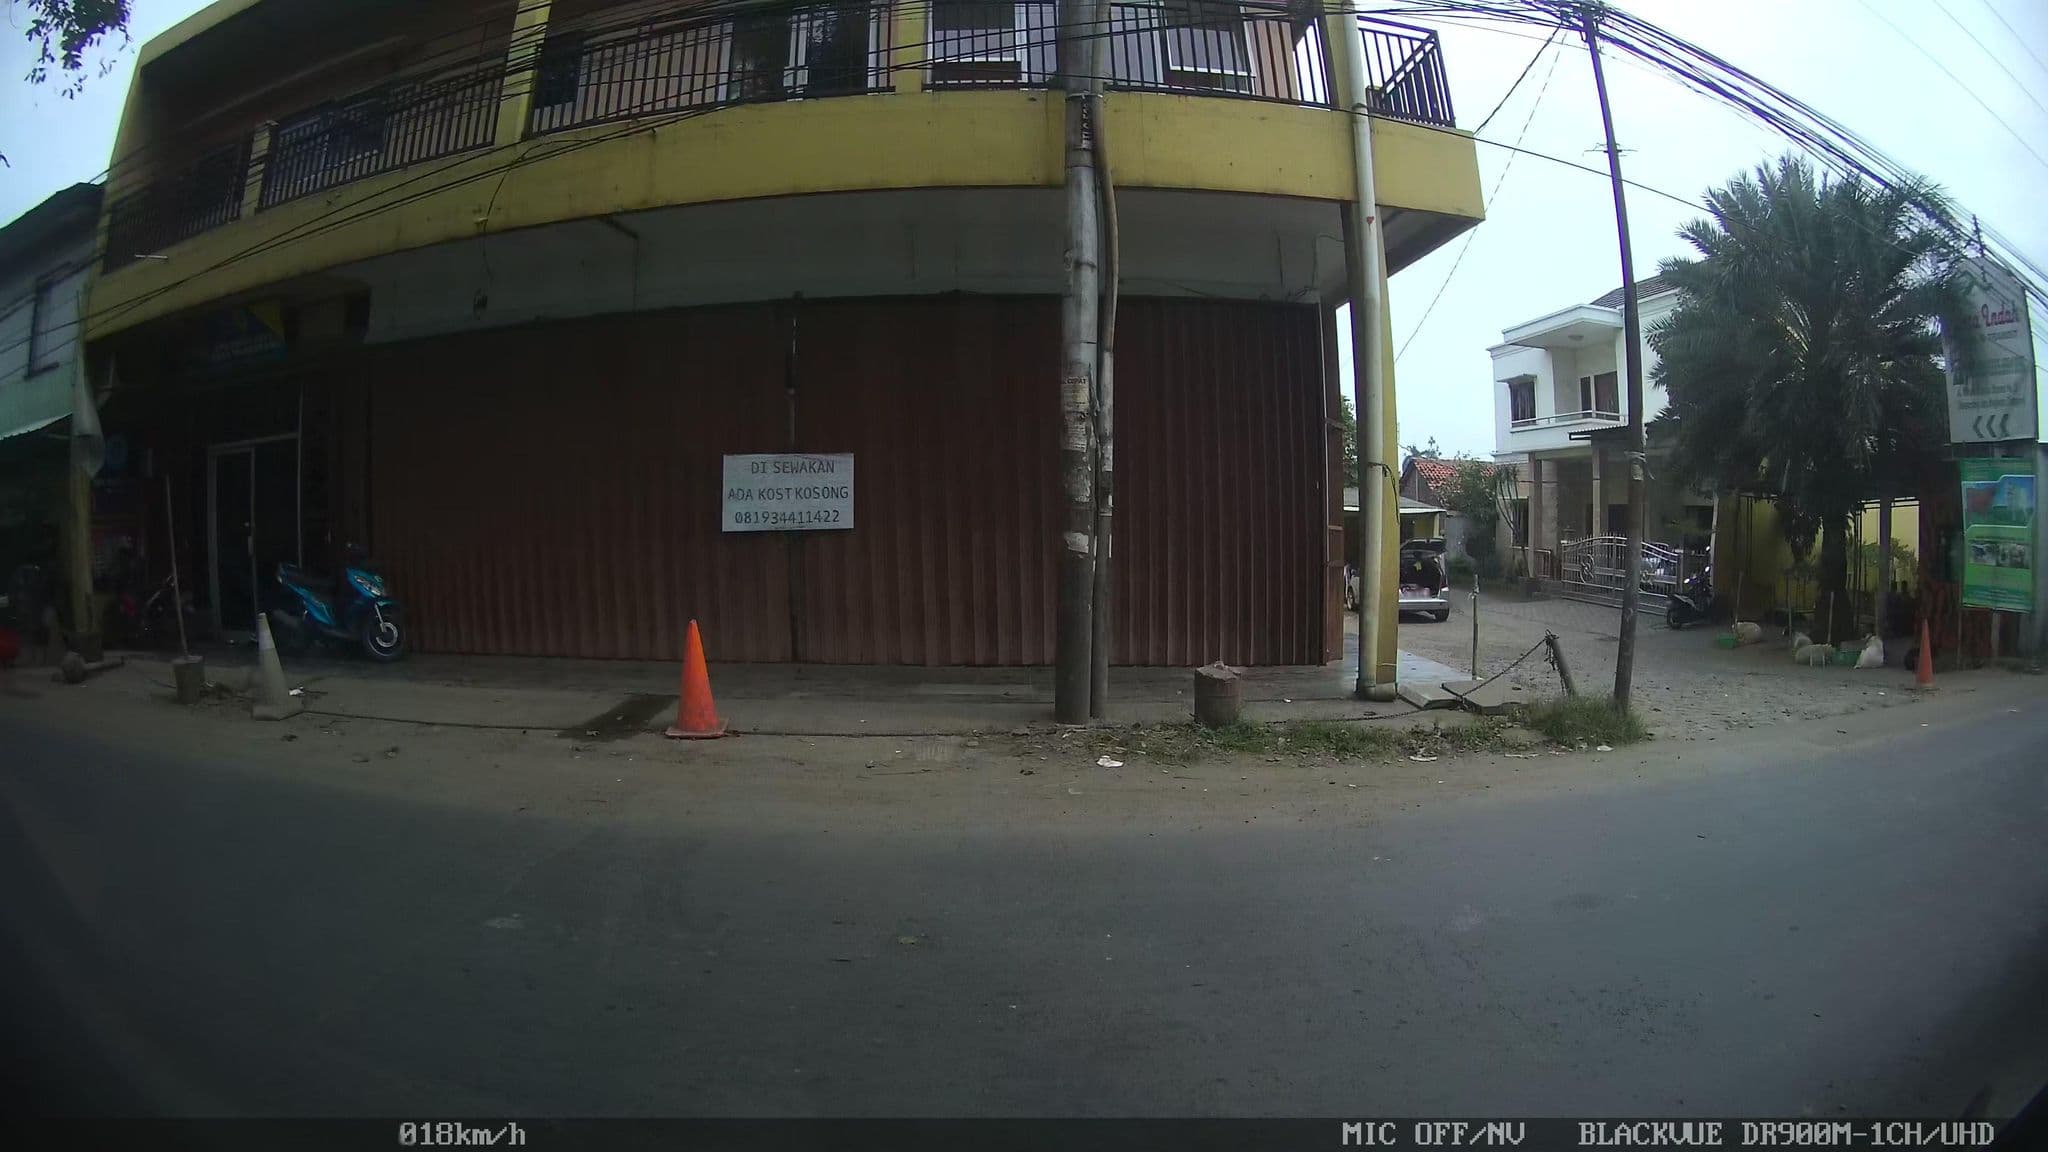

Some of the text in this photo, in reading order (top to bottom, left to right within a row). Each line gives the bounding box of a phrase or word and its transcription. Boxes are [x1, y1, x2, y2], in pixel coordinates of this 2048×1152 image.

[751, 461, 835, 474] DI SEWAKAN
[728, 488, 754, 501] ADA
[735, 510, 840, 525] 081934411422
